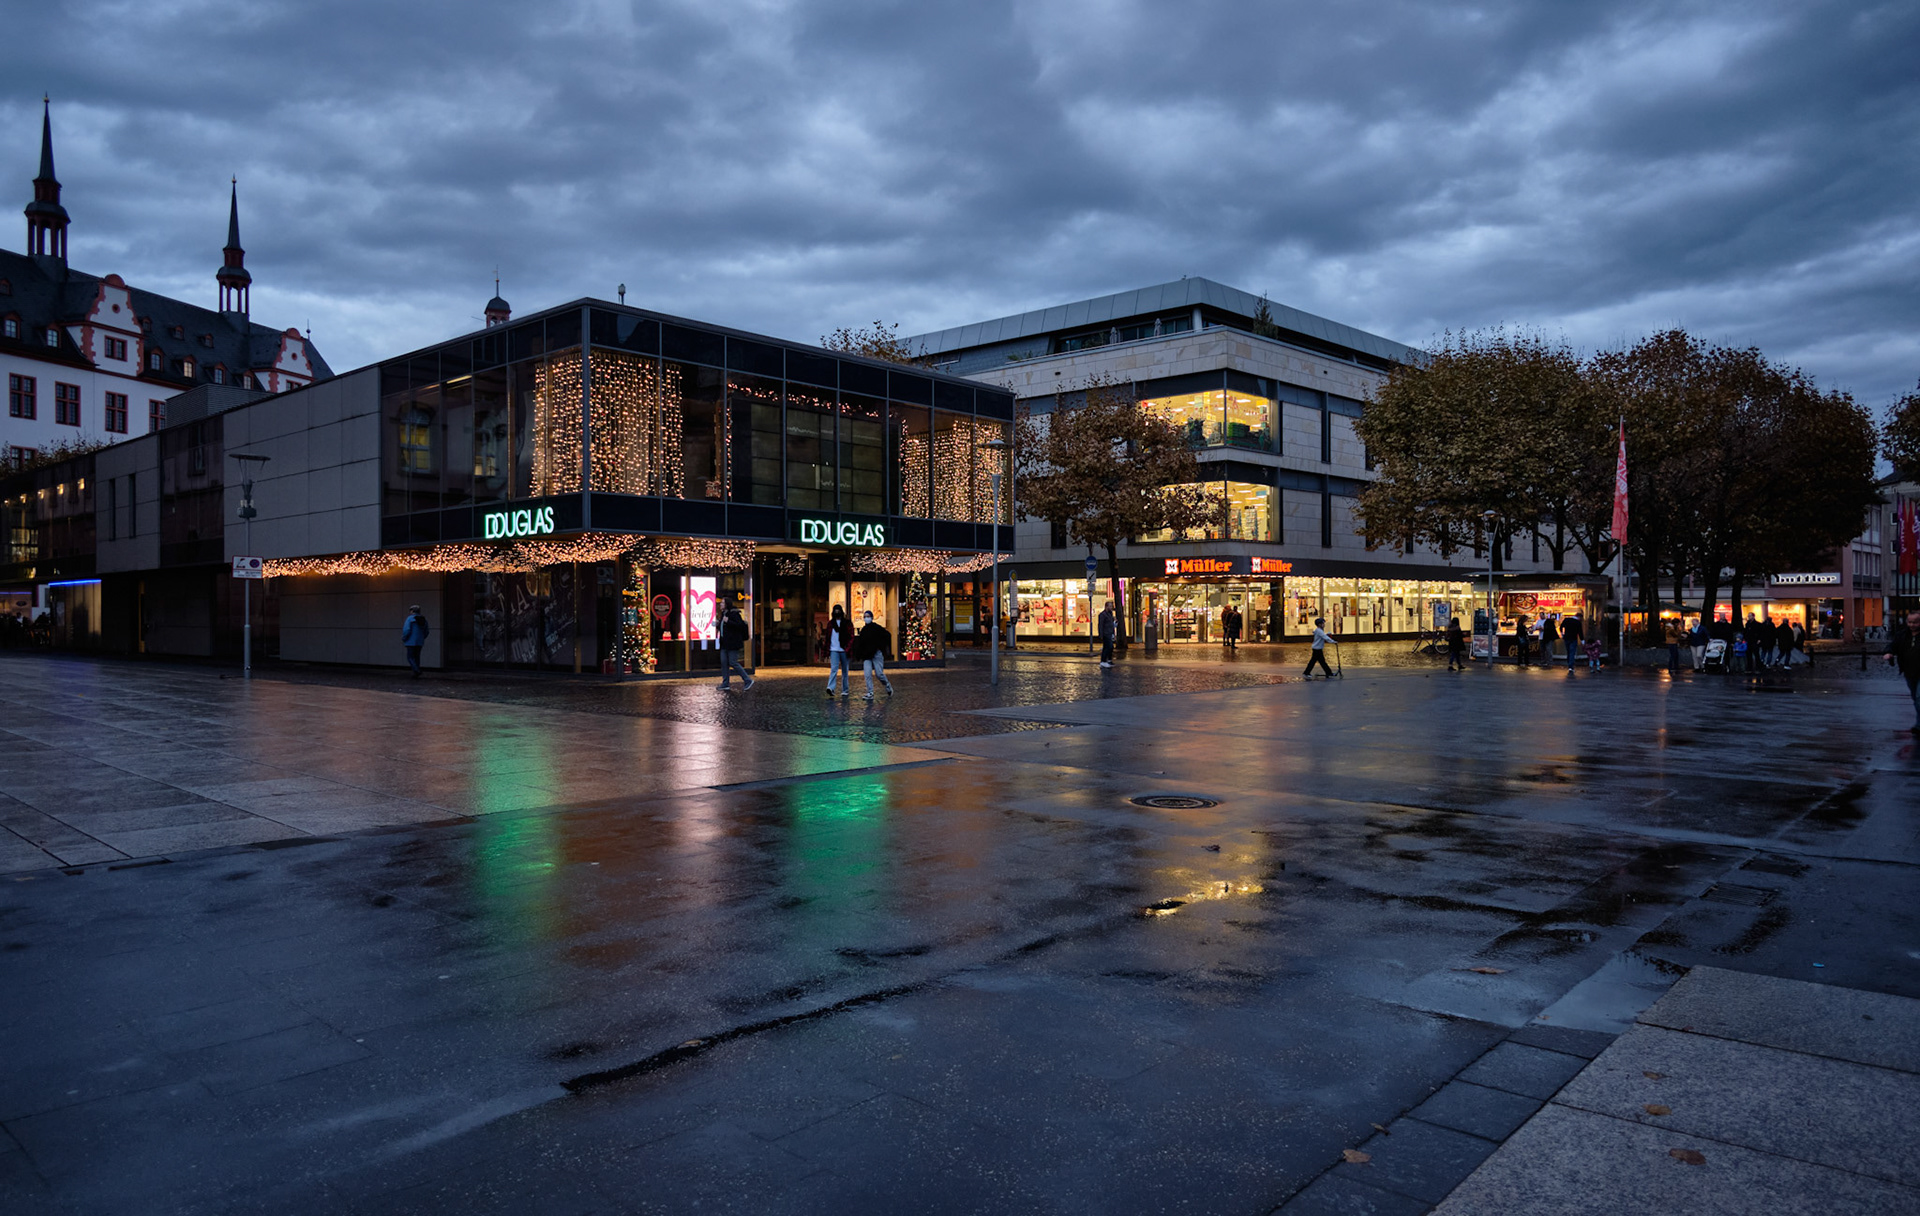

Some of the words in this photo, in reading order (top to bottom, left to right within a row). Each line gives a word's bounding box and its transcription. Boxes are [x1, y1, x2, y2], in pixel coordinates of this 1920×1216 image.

[484, 506, 555, 539] DOUGLAS
[800, 519, 885, 547] DOUGLAS
[1180, 558, 1233, 572] Müller
[1261, 558, 1293, 572] Müller
